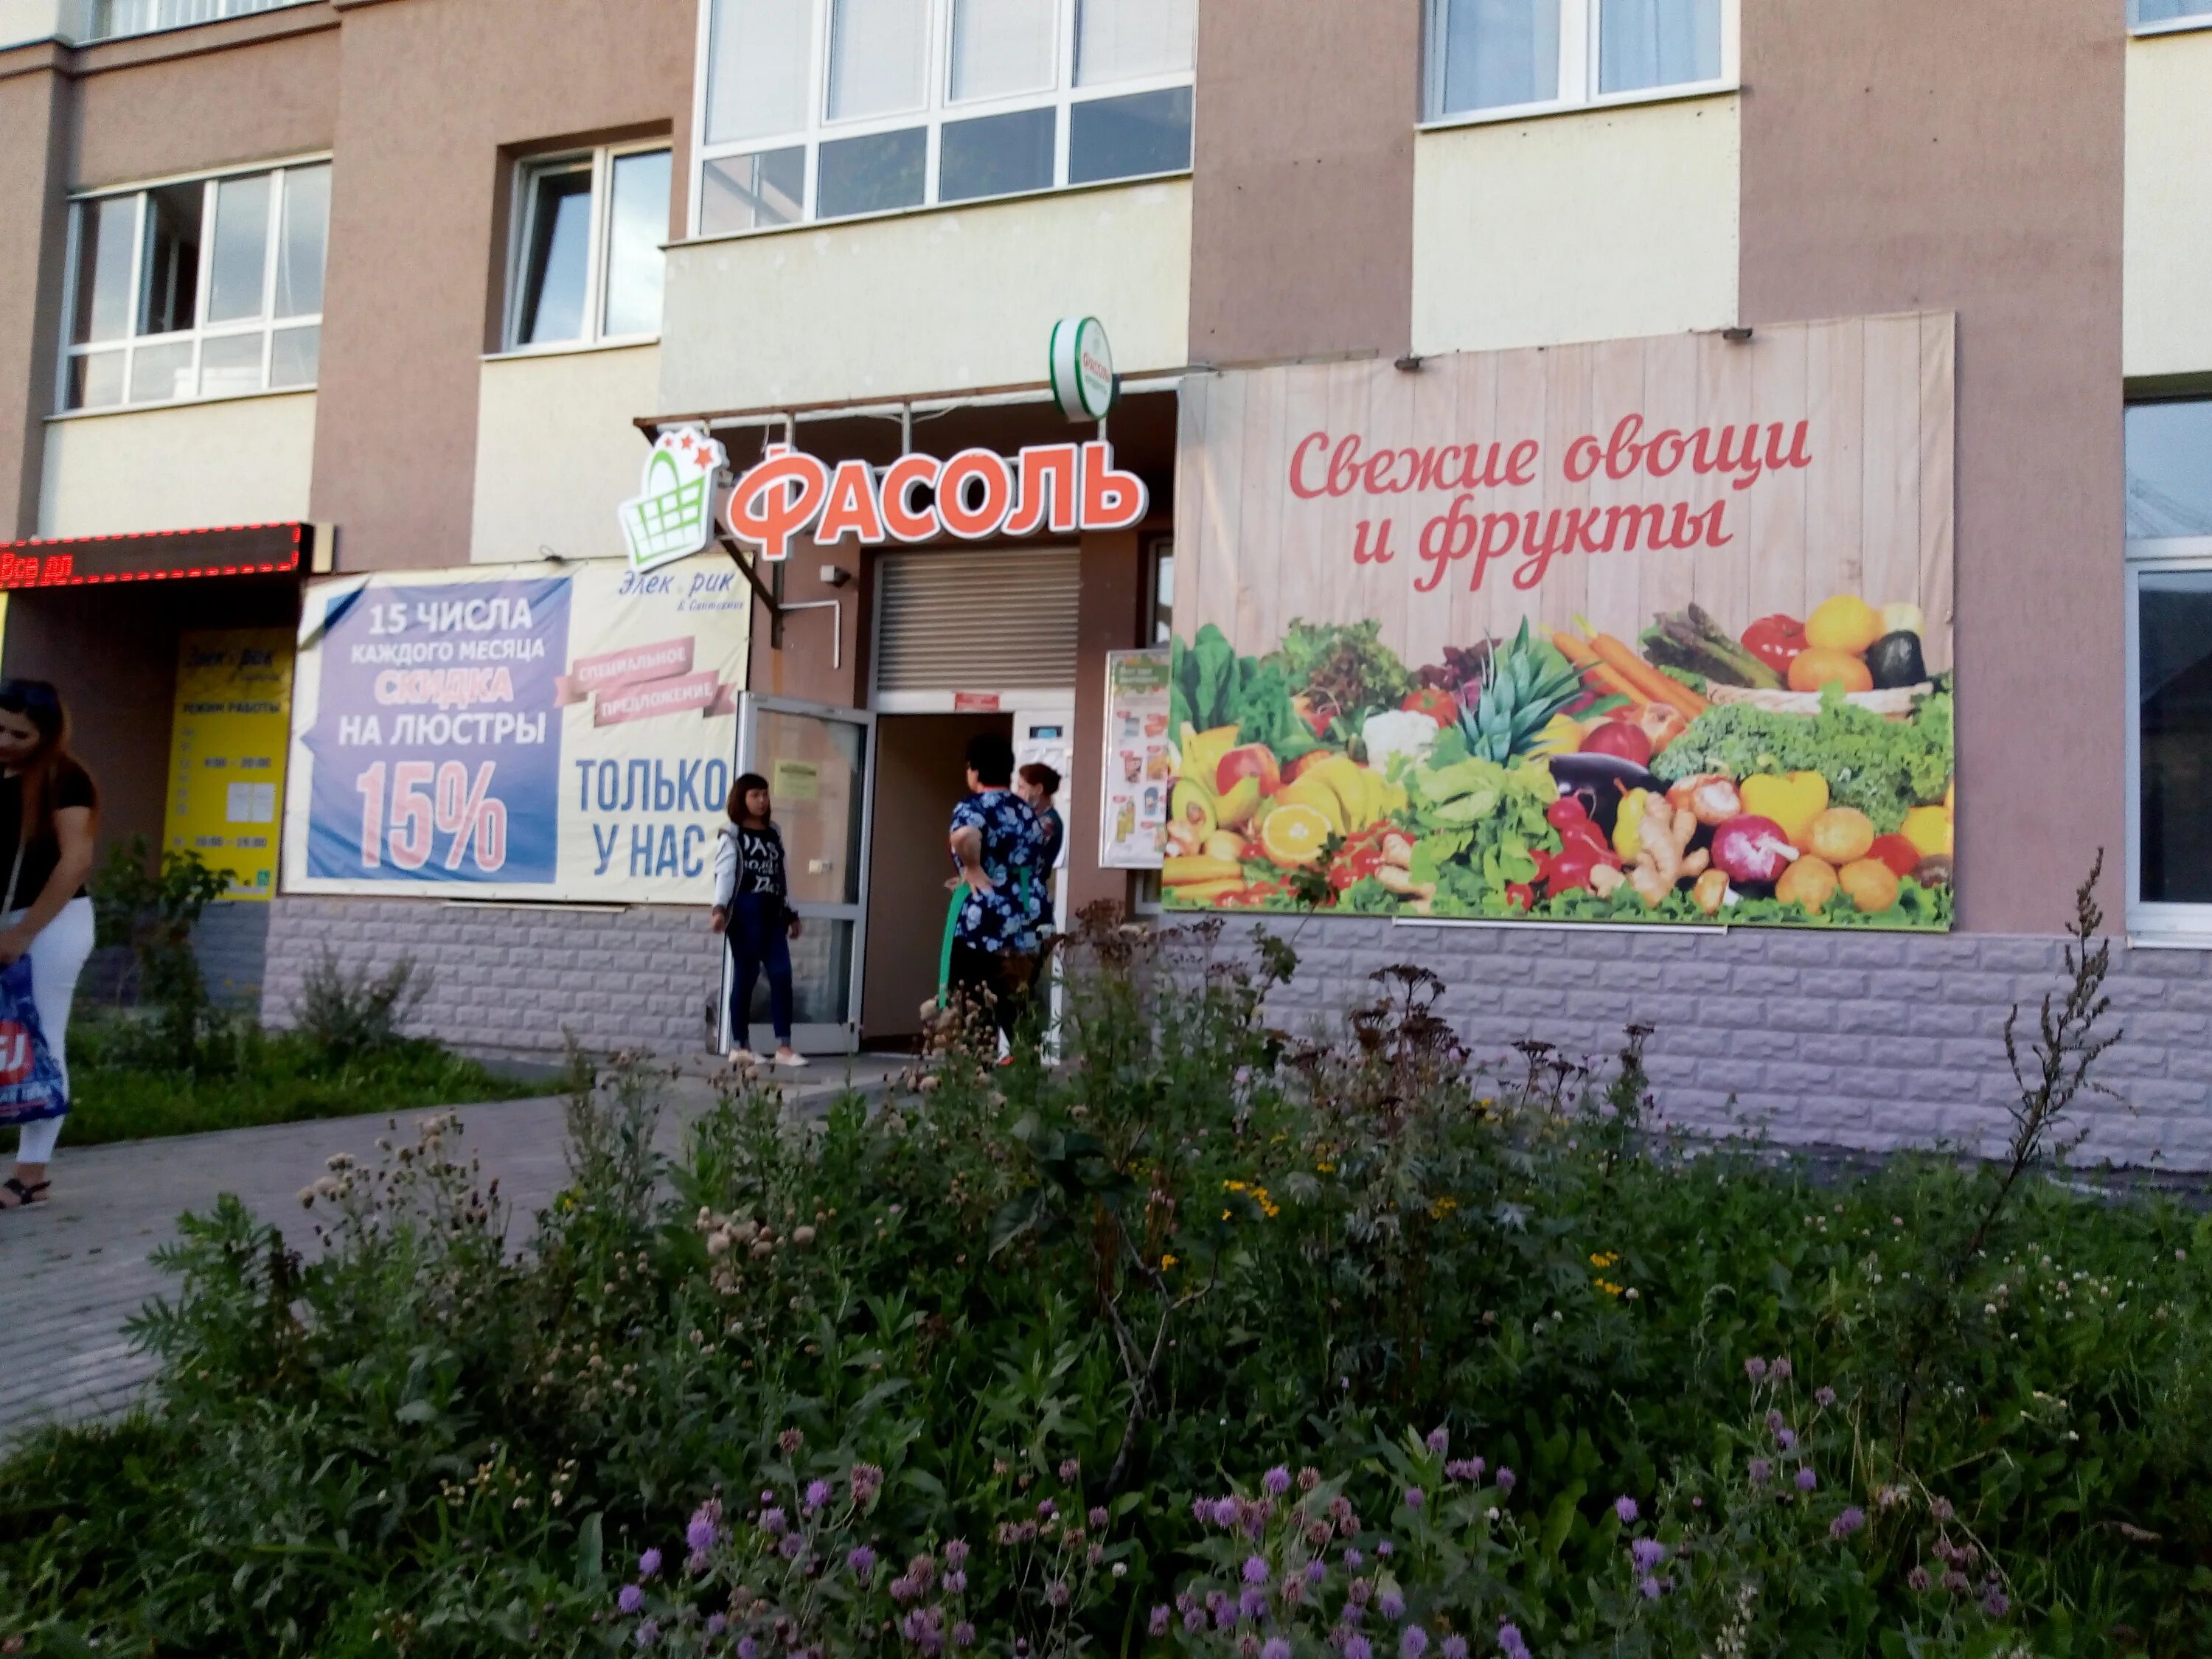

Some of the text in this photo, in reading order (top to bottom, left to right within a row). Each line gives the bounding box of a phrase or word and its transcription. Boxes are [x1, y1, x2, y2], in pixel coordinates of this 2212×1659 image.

[1289, 413, 1812, 499] Свежие овощи
[728, 443, 1147, 560] ФАСОЛЬ
[1353, 493, 1733, 592] и фрукты
[369, 597, 533, 635] 15 ЧИСЛА
[350, 639, 546, 665] КАЖДОГО МЕСЯЦА
[579, 647, 687, 682] СПЕЦИАЛЬНОЕ
[374, 666, 515, 710] СКИДКА
[601, 681, 714, 717] ПРЕДЛОЖЕНИЕ
[338, 711, 547, 745] НА ЛЮСТРЫ
[575, 758, 728, 813] ТОЛЬКО
[356, 759, 507, 872] 15%
[592, 823, 705, 879] У НАС
